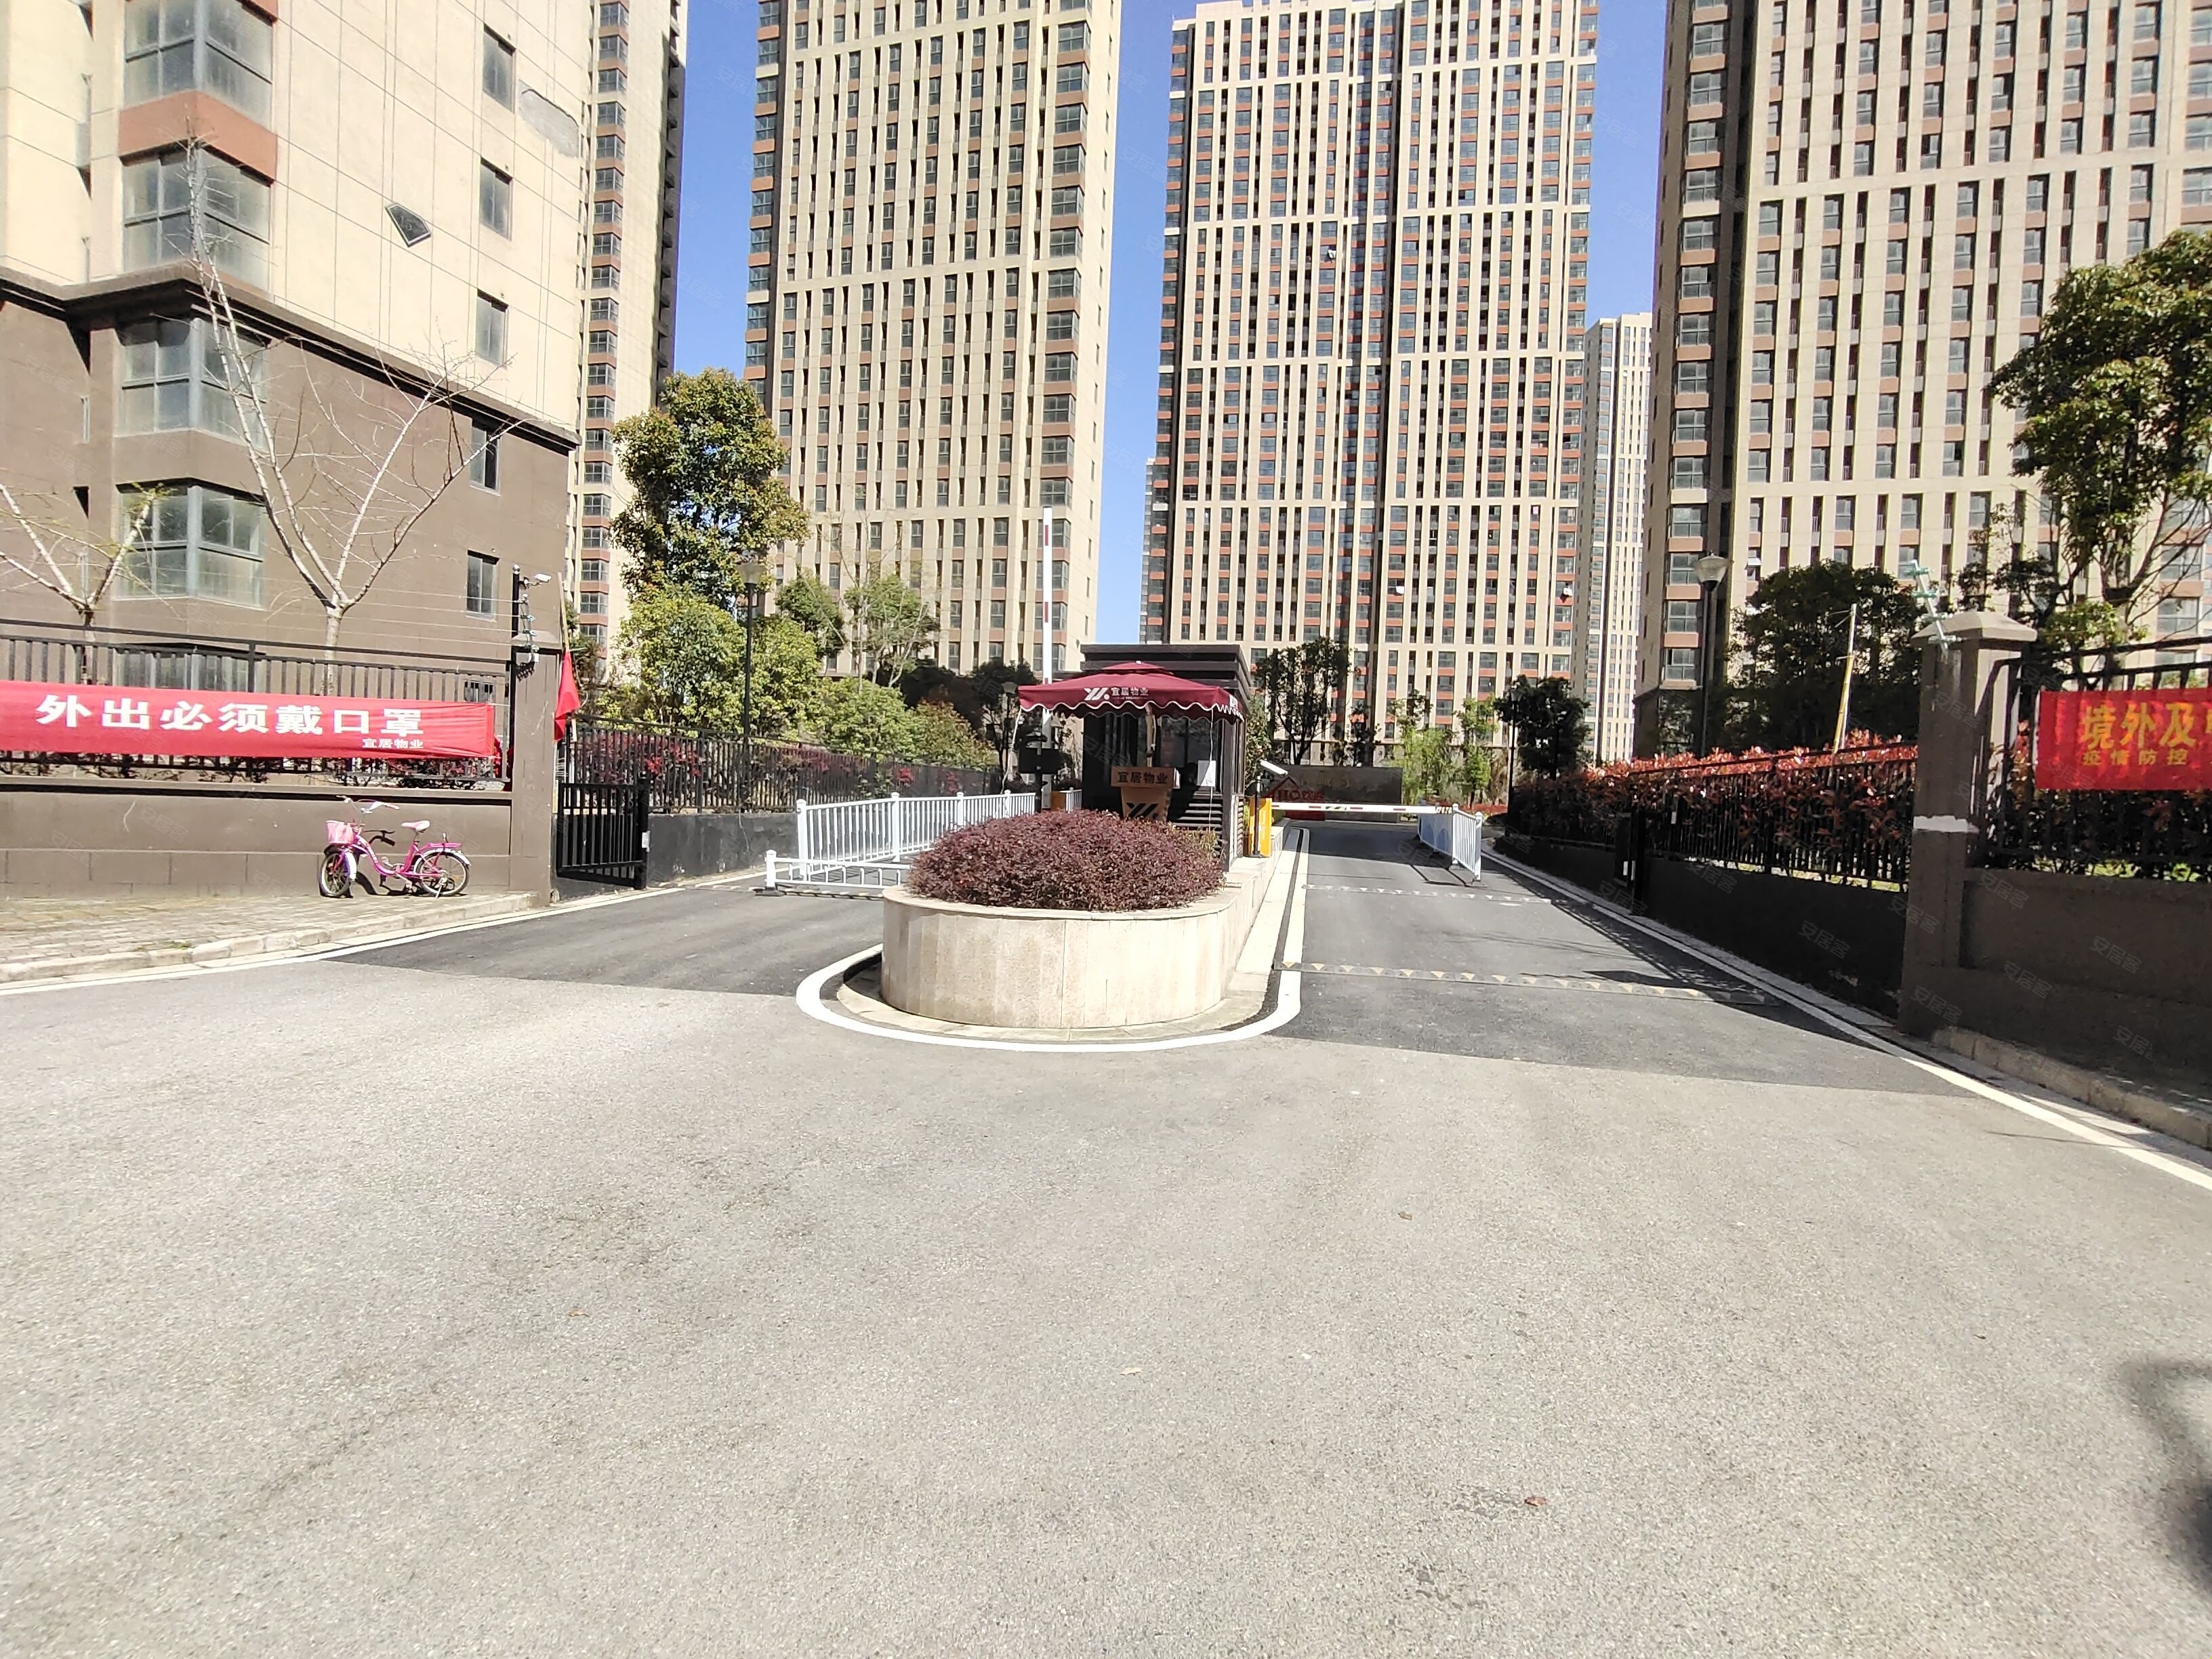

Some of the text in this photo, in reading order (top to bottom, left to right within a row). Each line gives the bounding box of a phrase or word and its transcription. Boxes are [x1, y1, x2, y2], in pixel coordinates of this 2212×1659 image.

[1111, 687, 1149, 697] 宜居物业
[36, 693, 424, 737] 外出必须戴口罩
[362, 737, 424, 749] 宜居物业
[2083, 748, 2189, 766] 疫情防控
[1117, 771, 1168, 784] 宜居物业
